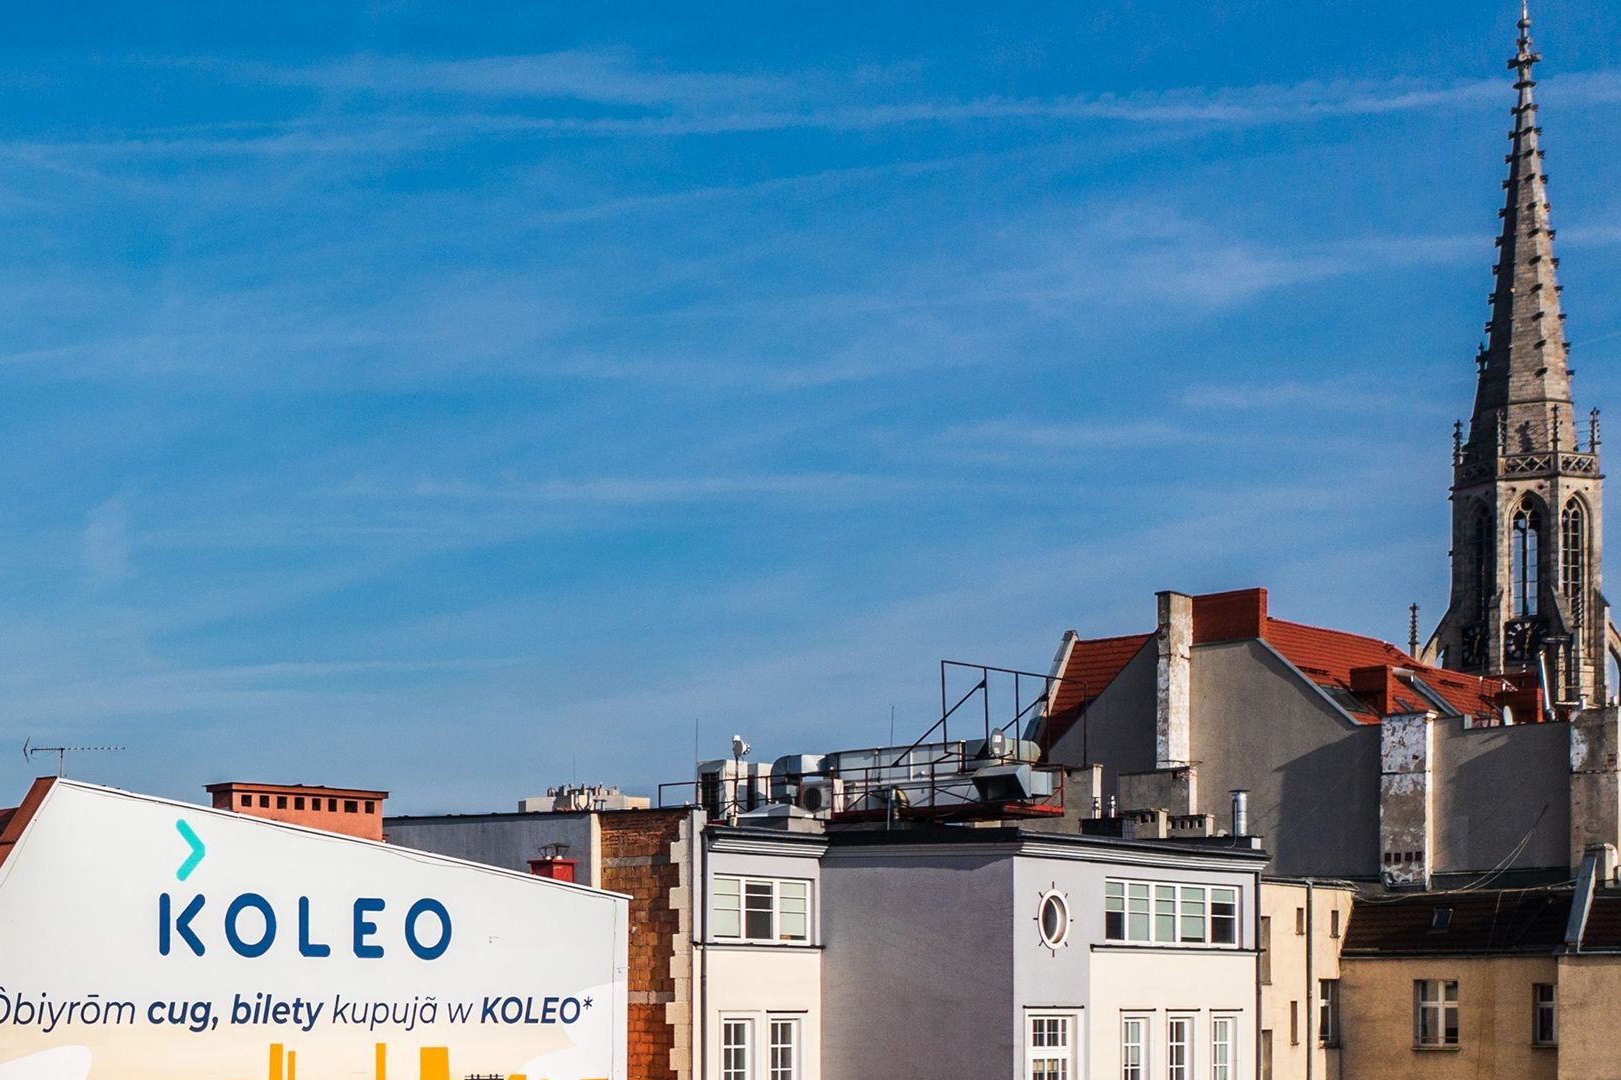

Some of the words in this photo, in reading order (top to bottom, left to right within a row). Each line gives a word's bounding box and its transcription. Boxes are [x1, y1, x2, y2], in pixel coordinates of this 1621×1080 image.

[158, 892, 452, 961] KOLEO
[147, 1001, 219, 1033] cug,
[230, 992, 325, 1032] bilety
[332, 994, 438, 1032] kupujã
[447, 1002, 474, 1024] w
